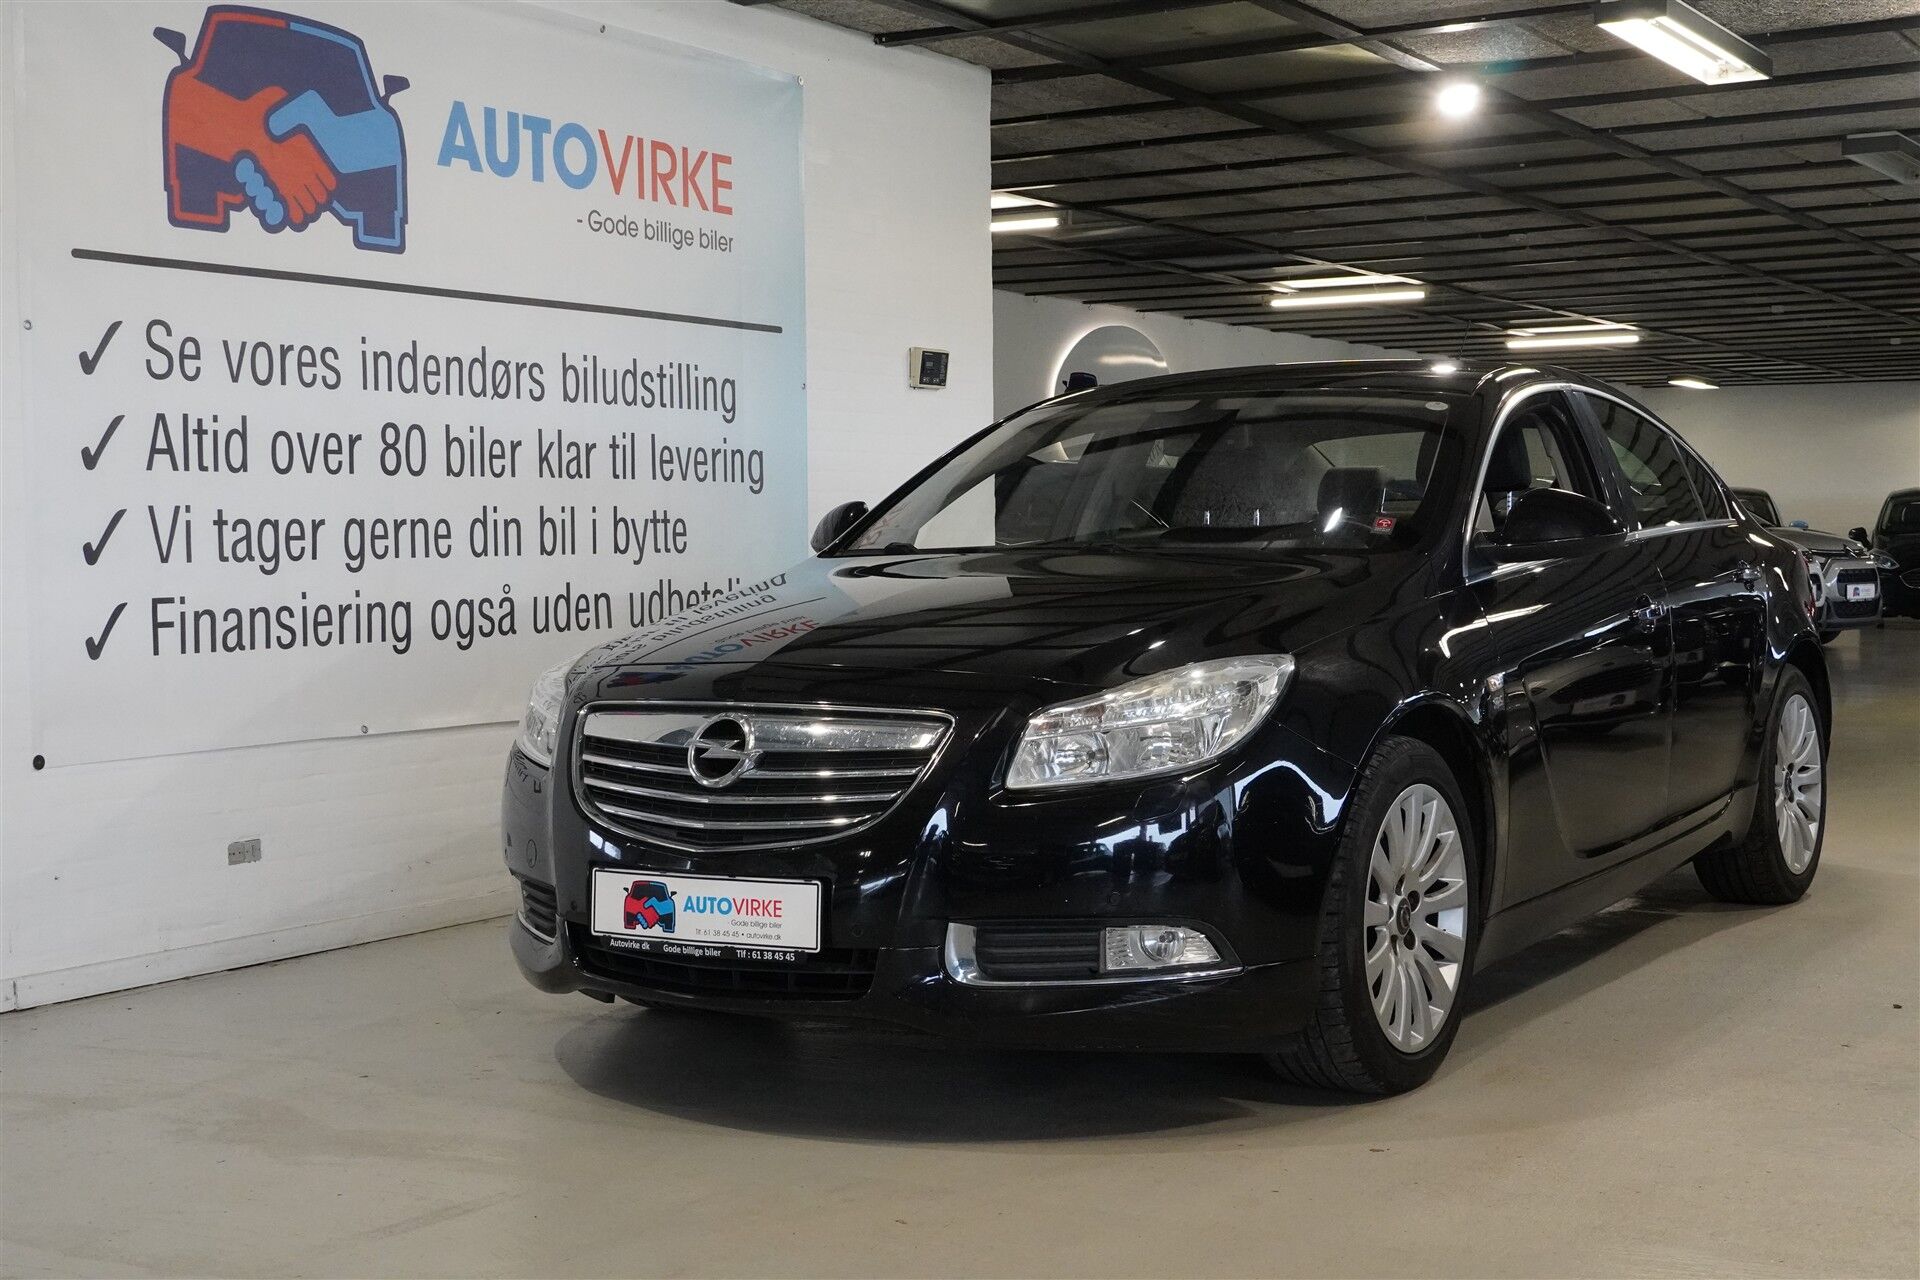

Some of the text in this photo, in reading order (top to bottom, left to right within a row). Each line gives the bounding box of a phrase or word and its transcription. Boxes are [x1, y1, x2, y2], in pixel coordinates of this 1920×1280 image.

[438, 101, 733, 215] AUTOVIRKE
[588, 210, 638, 238] Gode
[644, 218, 695, 250] billige
[700, 228, 734, 253] biler
[146, 319, 737, 424] Se vores indendørs biludstilling
[146, 413, 764, 494] Altid over 80 biler klar til levering
[148, 505, 687, 575] Vi tager gerne din bil i bytte
[152, 590, 411, 656] Finansiering
[431, 584, 517, 651] også
[533, 582, 612, 634] uden
[683, 895, 782, 918] AUTOVIRKE
[712, 929, 720, 937] 38
[722, 930, 730, 938] 45
[731, 930, 740, 938] 45
[731, 919, 749, 928] Gode
[610, 939, 640, 949] Autovirke
[663, 944, 681, 953] Gode
[704, 947, 721, 956] biler
[736, 949, 747, 958] Tlf
[751, 950, 761, 959] 61
[763, 951, 773, 960] 38
[774, 952, 784, 960] 45
[785, 953, 795, 961] 45
